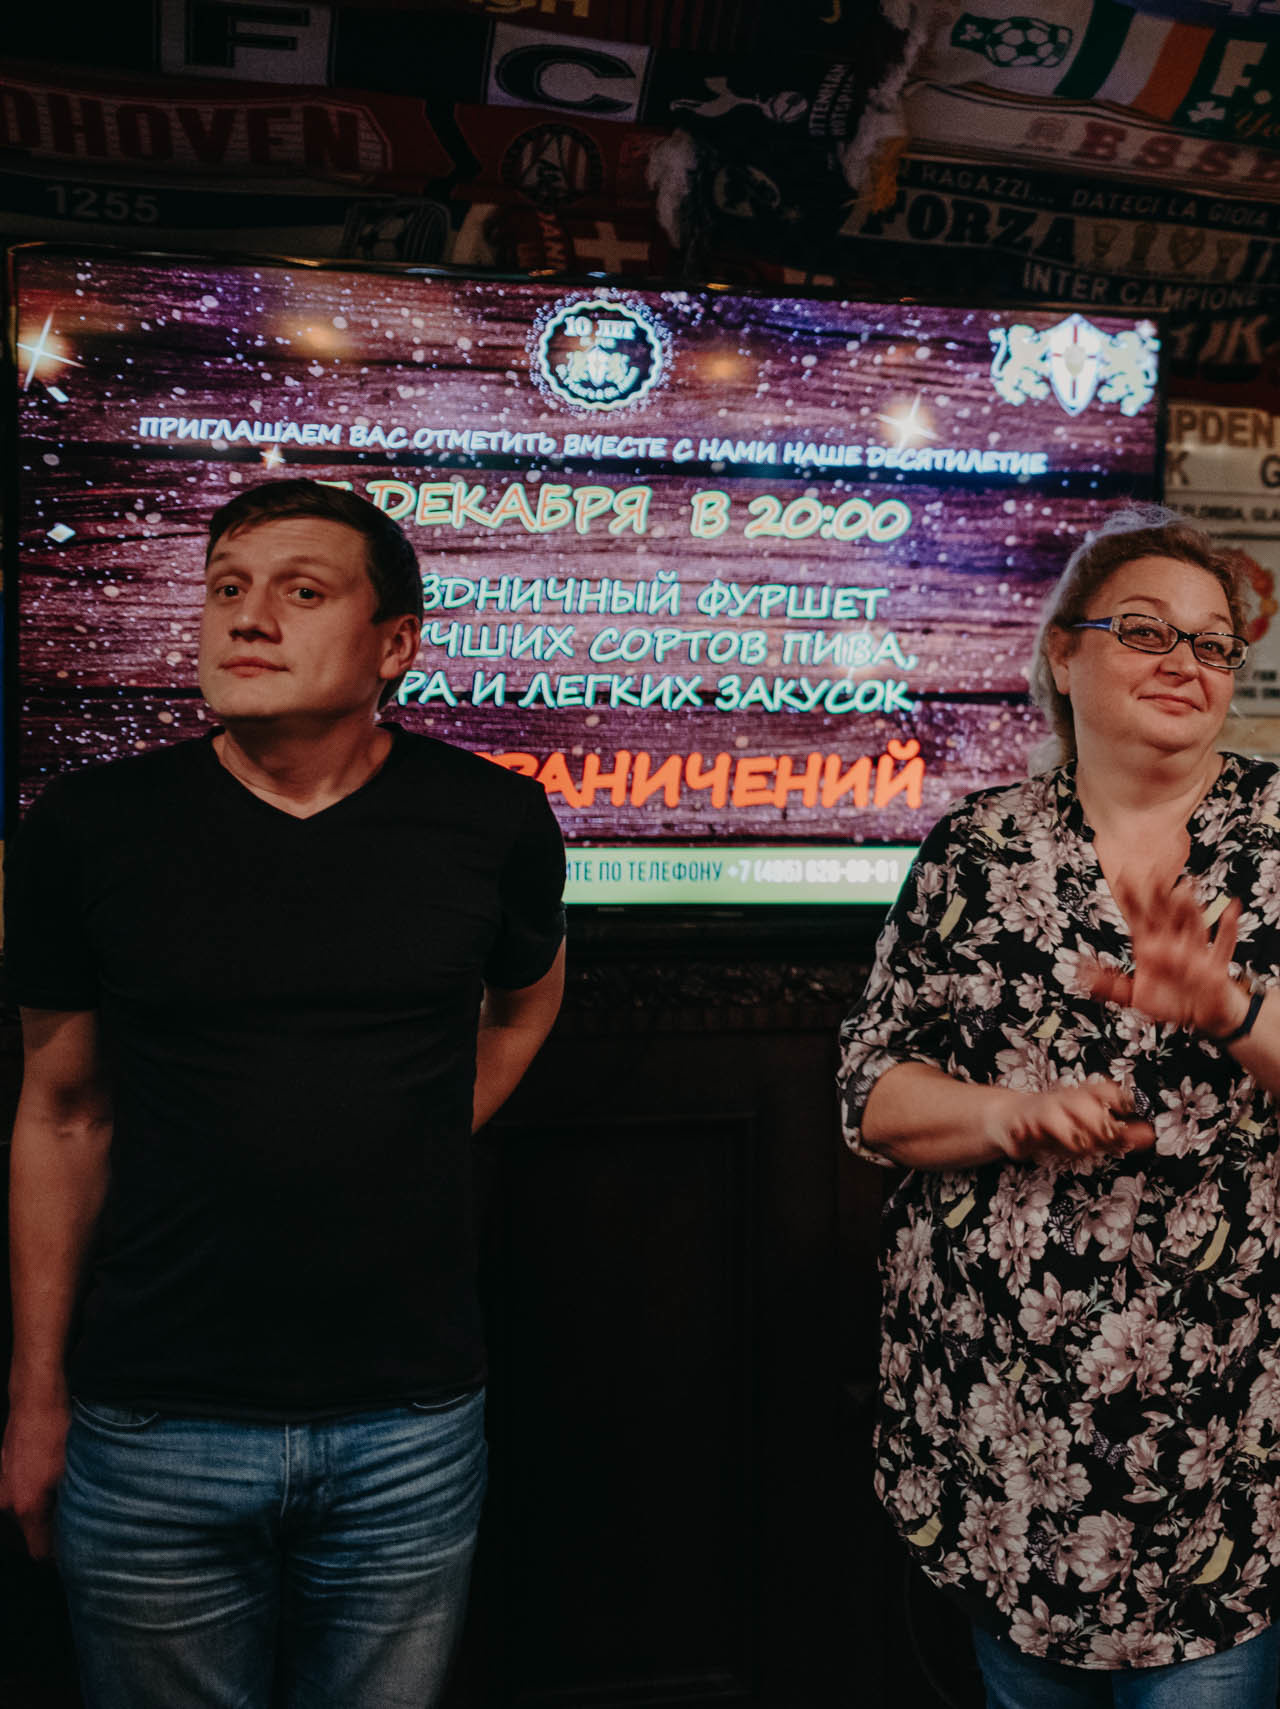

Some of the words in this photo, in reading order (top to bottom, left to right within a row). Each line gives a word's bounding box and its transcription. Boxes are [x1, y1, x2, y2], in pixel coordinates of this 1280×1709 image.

[45, 185, 160, 225] 1255
[1166, 198, 1198, 219] LA
[1021, 258, 1110, 301] INTER
[564, 315, 593, 337] 10
[139, 416, 341, 446] ПРИГЛАШАЕМ
[349, 424, 407, 450] ВАС
[413, 427, 556, 455] ОТМЕТИТЬ
[563, 433, 667, 461] ВМЕСТЕ
[671, 439, 696, 463] С
[698, 438, 777, 465] НАМИ
[783, 441, 864, 468] НАШЕ
[866, 445, 1050, 476] ДЕСЯТИЛЕТИЕ
[365, 481, 654, 536] ДЕКАБРЯ
[690, 490, 731, 540] В
[743, 493, 912, 543] 20:00
[696, 579, 889, 621] ФУРШЕТ
[588, 626, 767, 667] СОРТОВ
[782, 629, 920, 671] ПИВА,
[471, 670, 507, 707] И
[516, 671, 703, 711] ЛЕГКИХ
[714, 674, 917, 714] ЗАКУСОК
[474, 739, 926, 810] АНИЧЕНИЙ
[598, 861, 622, 882] ПО
[628, 860, 723, 883] ТЕЛЕФОНУ
[728, 860, 752, 883] +7
